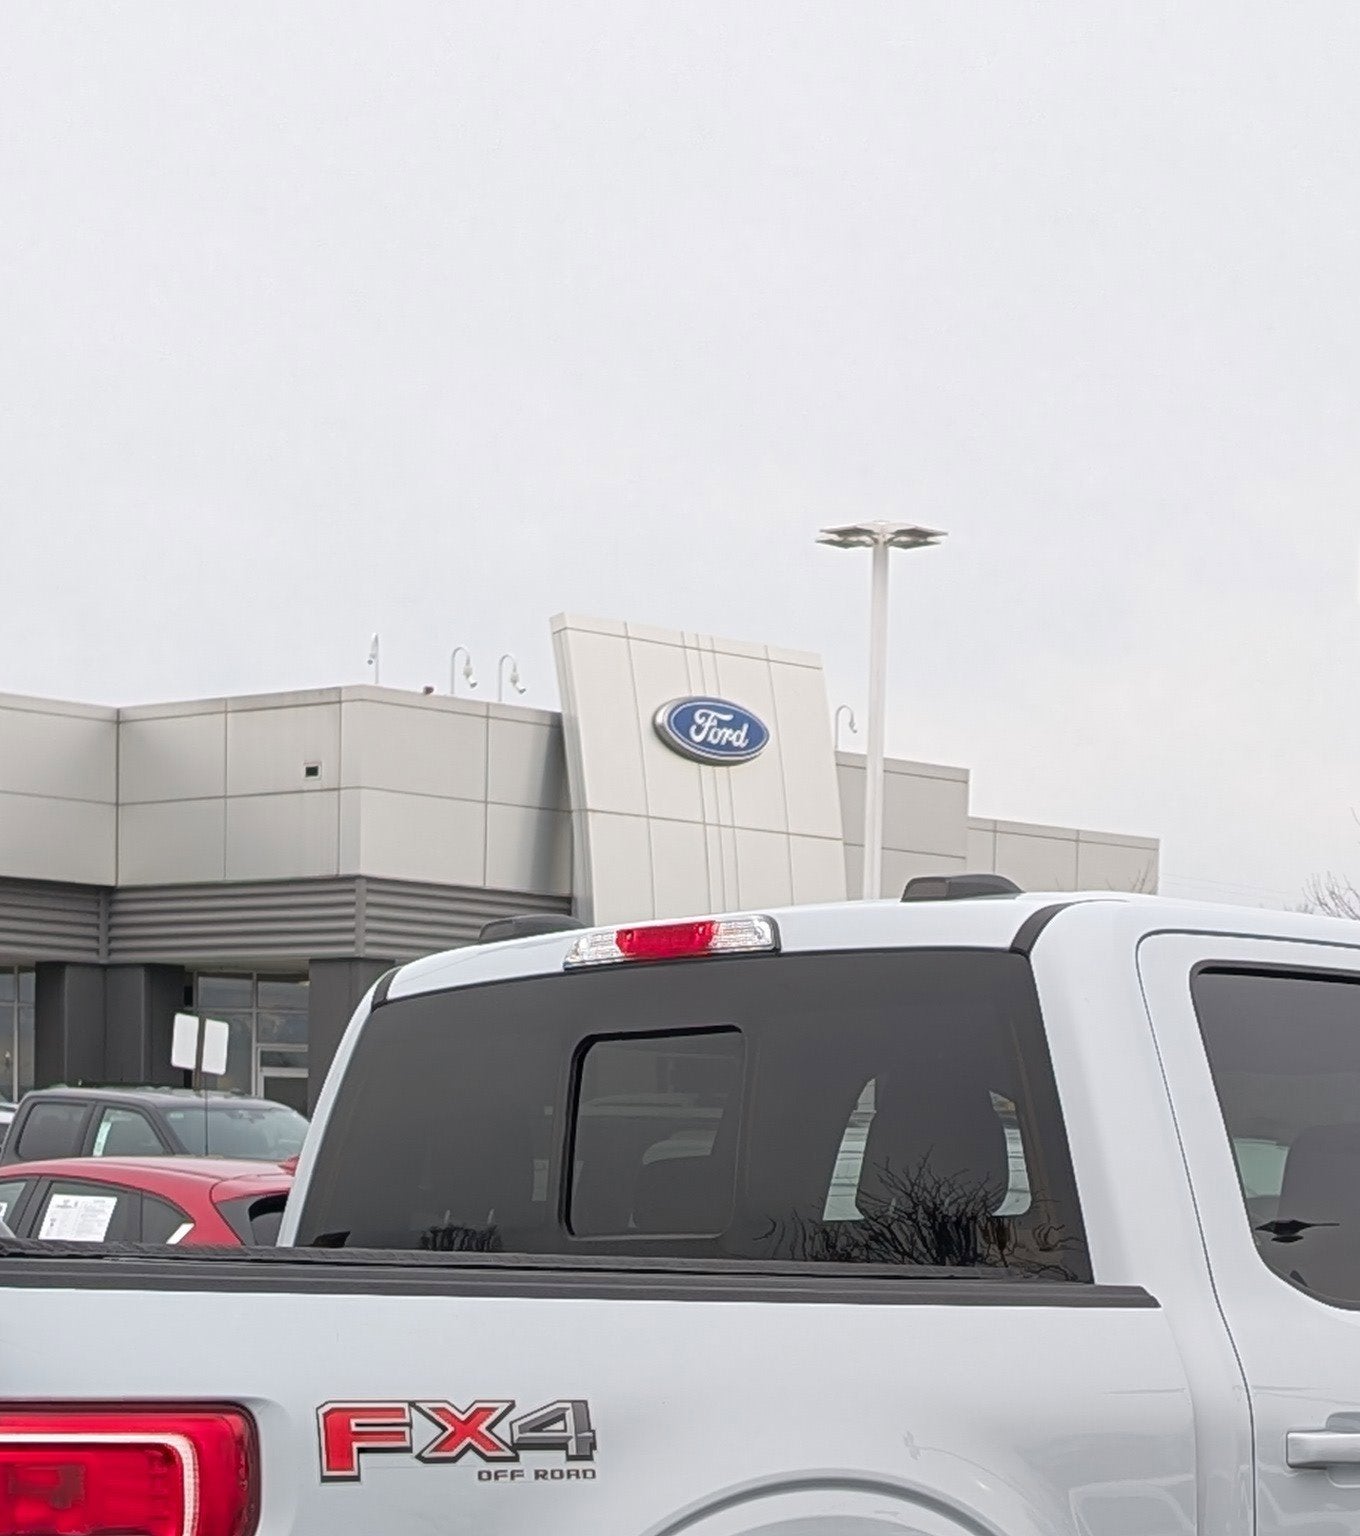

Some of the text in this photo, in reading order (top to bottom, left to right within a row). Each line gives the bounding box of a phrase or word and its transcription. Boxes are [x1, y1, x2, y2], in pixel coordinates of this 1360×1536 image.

[689, 709, 749, 748] Ford
[316, 1400, 597, 1483] FX4
[477, 1468, 597, 1481] OFF ROAD
